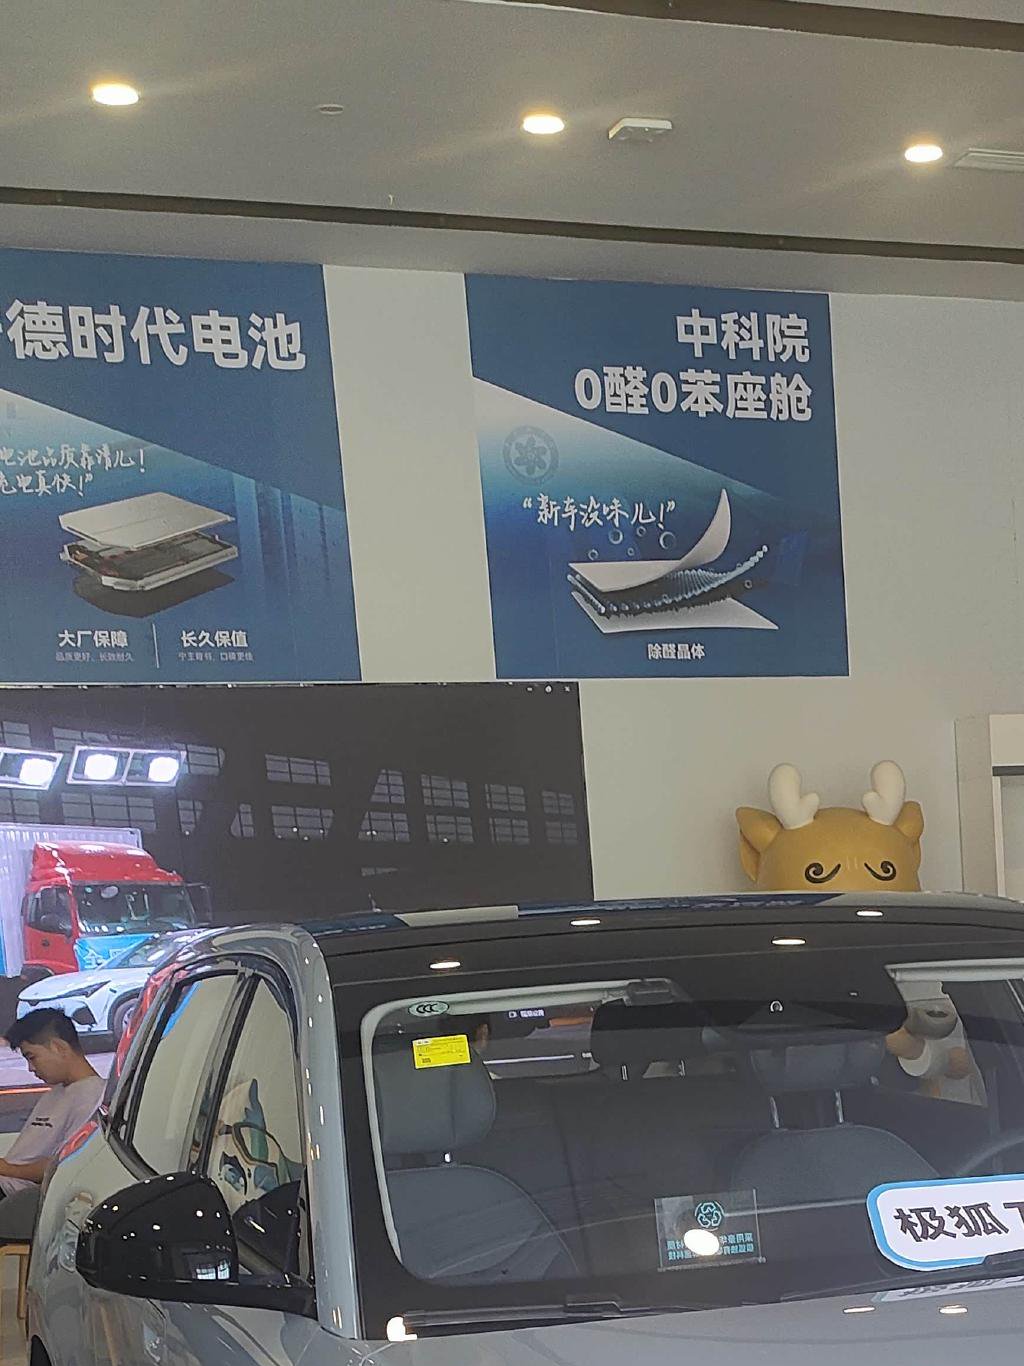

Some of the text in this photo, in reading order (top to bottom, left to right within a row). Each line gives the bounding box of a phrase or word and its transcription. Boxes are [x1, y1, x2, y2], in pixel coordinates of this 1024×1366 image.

[0, 299, 306, 371] 德时代电池
[676, 308, 811, 363] 中科院
[574, 365, 813, 421] 0醛0苯座舱
[58, 629, 128, 648] 大厂保障
[181, 630, 248, 648] 长久保值
[647, 643, 705, 661] 除醛晶体
